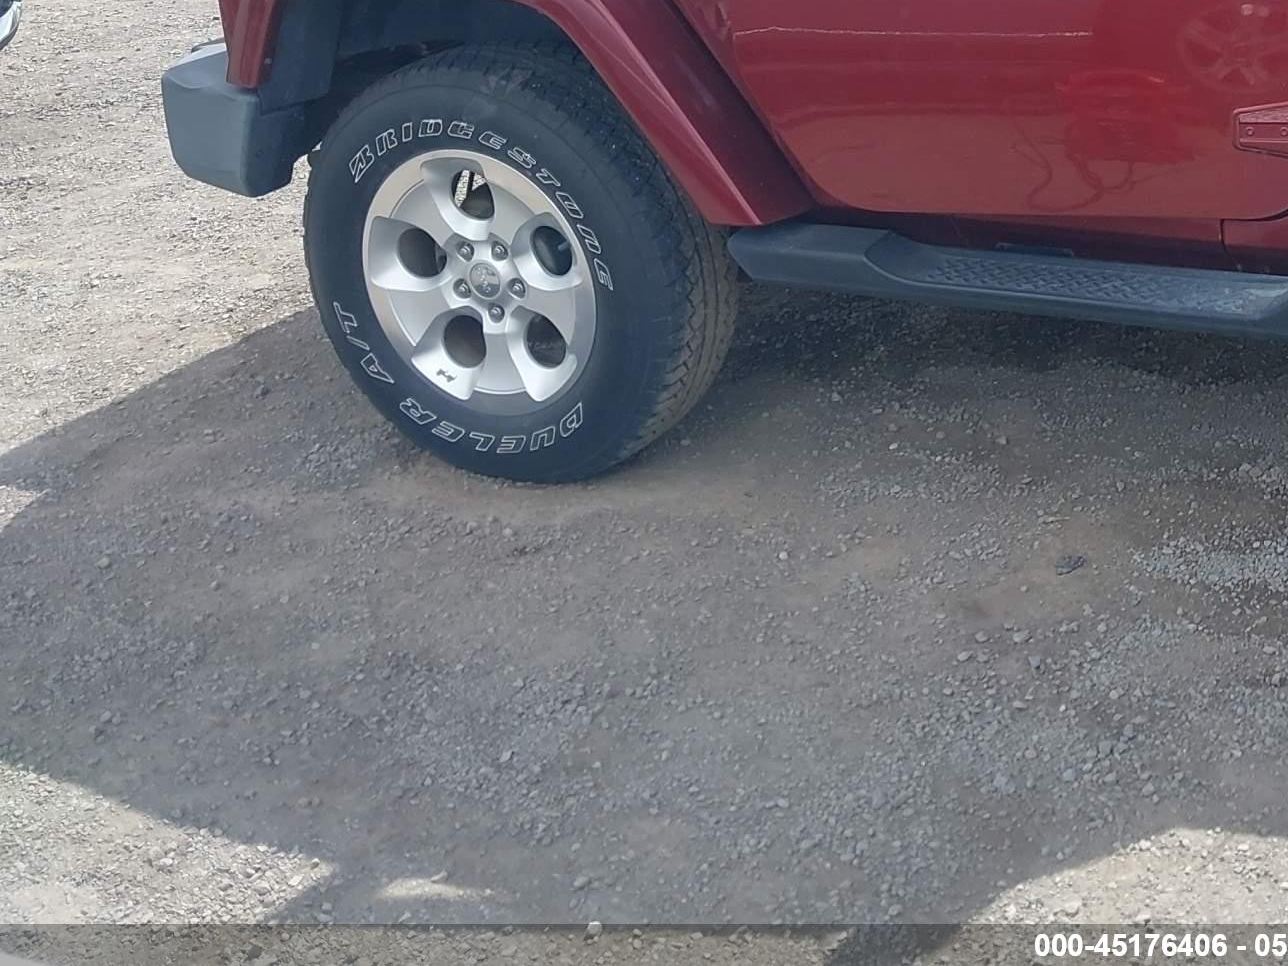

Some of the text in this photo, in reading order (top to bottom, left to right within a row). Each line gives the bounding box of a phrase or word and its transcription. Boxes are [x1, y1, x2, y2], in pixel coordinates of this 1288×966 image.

[349, 119, 613, 291] BRIDGESTONE
[334, 301, 584, 454] DUELER A/T
